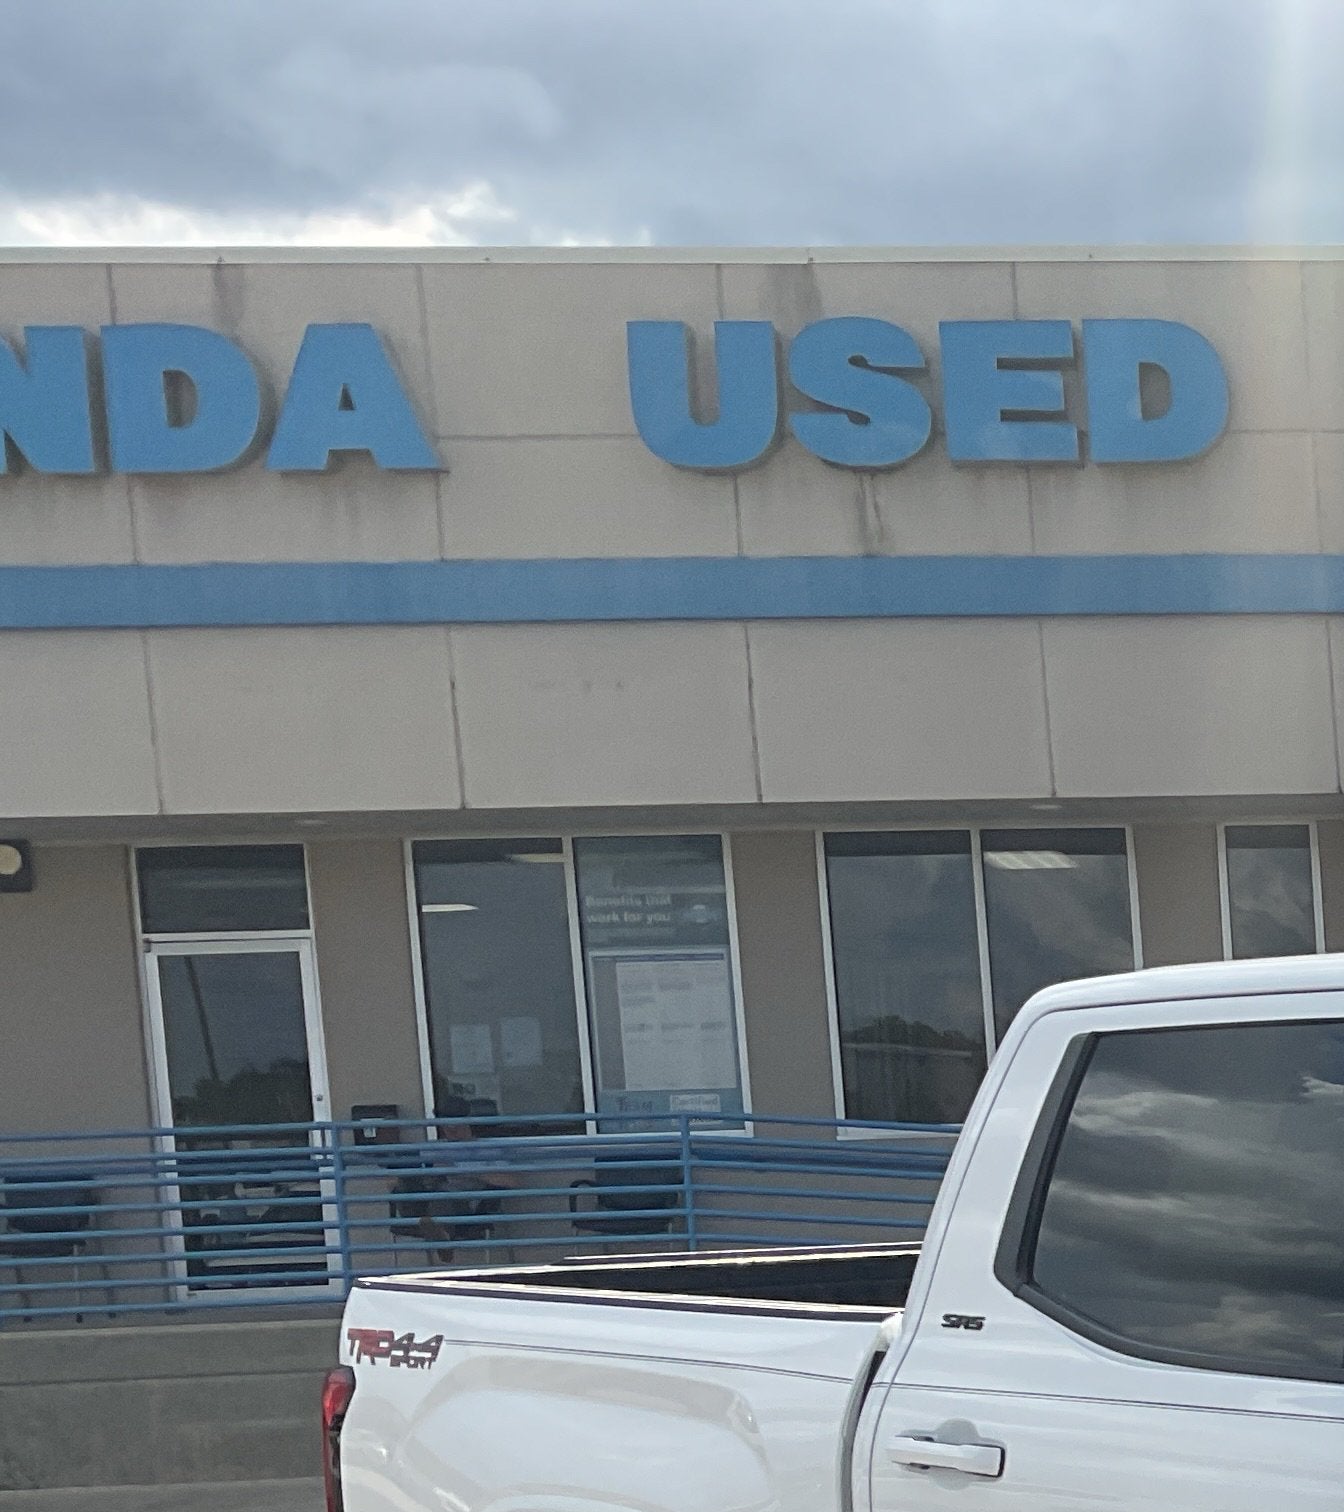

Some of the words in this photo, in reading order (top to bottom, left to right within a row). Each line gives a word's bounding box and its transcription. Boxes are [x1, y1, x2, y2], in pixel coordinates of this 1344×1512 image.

[626, 316, 1230, 468] USED
[586, 911, 620, 923] work
[624, 911, 642, 922] for
